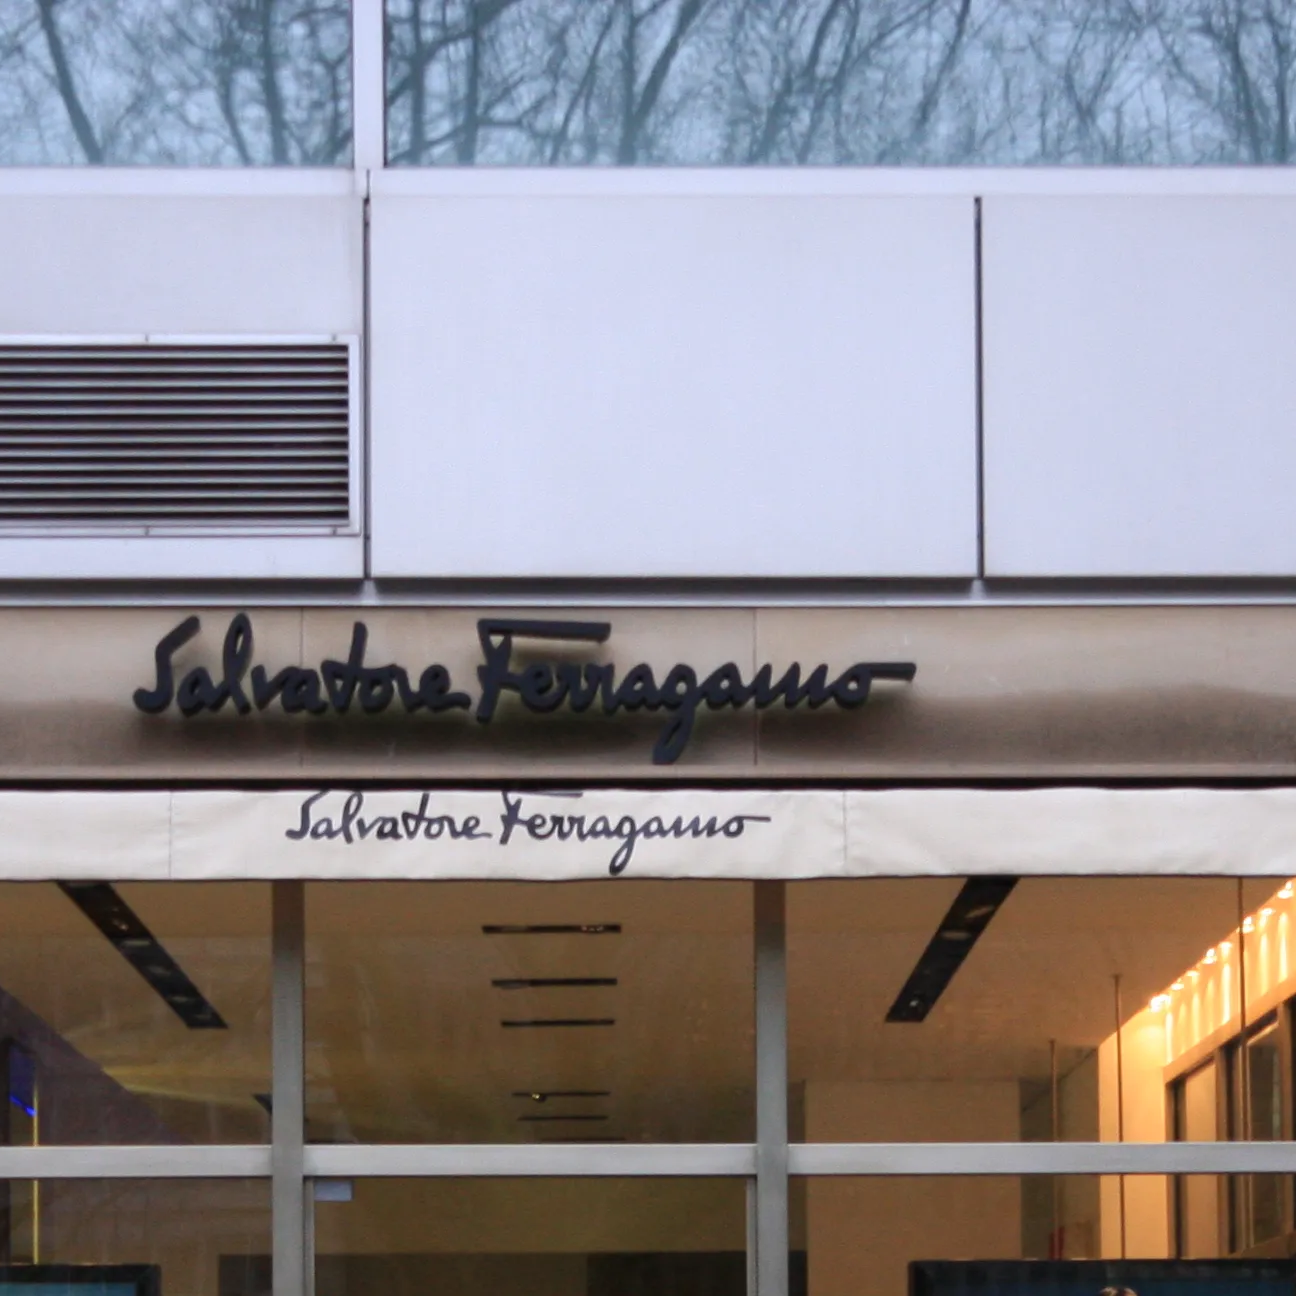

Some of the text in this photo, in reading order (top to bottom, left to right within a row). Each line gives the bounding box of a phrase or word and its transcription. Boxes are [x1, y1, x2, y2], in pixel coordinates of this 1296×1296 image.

[133, 613, 916, 765] Salvatore Ferragamo
[285, 790, 771, 875] Salvatore Ferragamo
